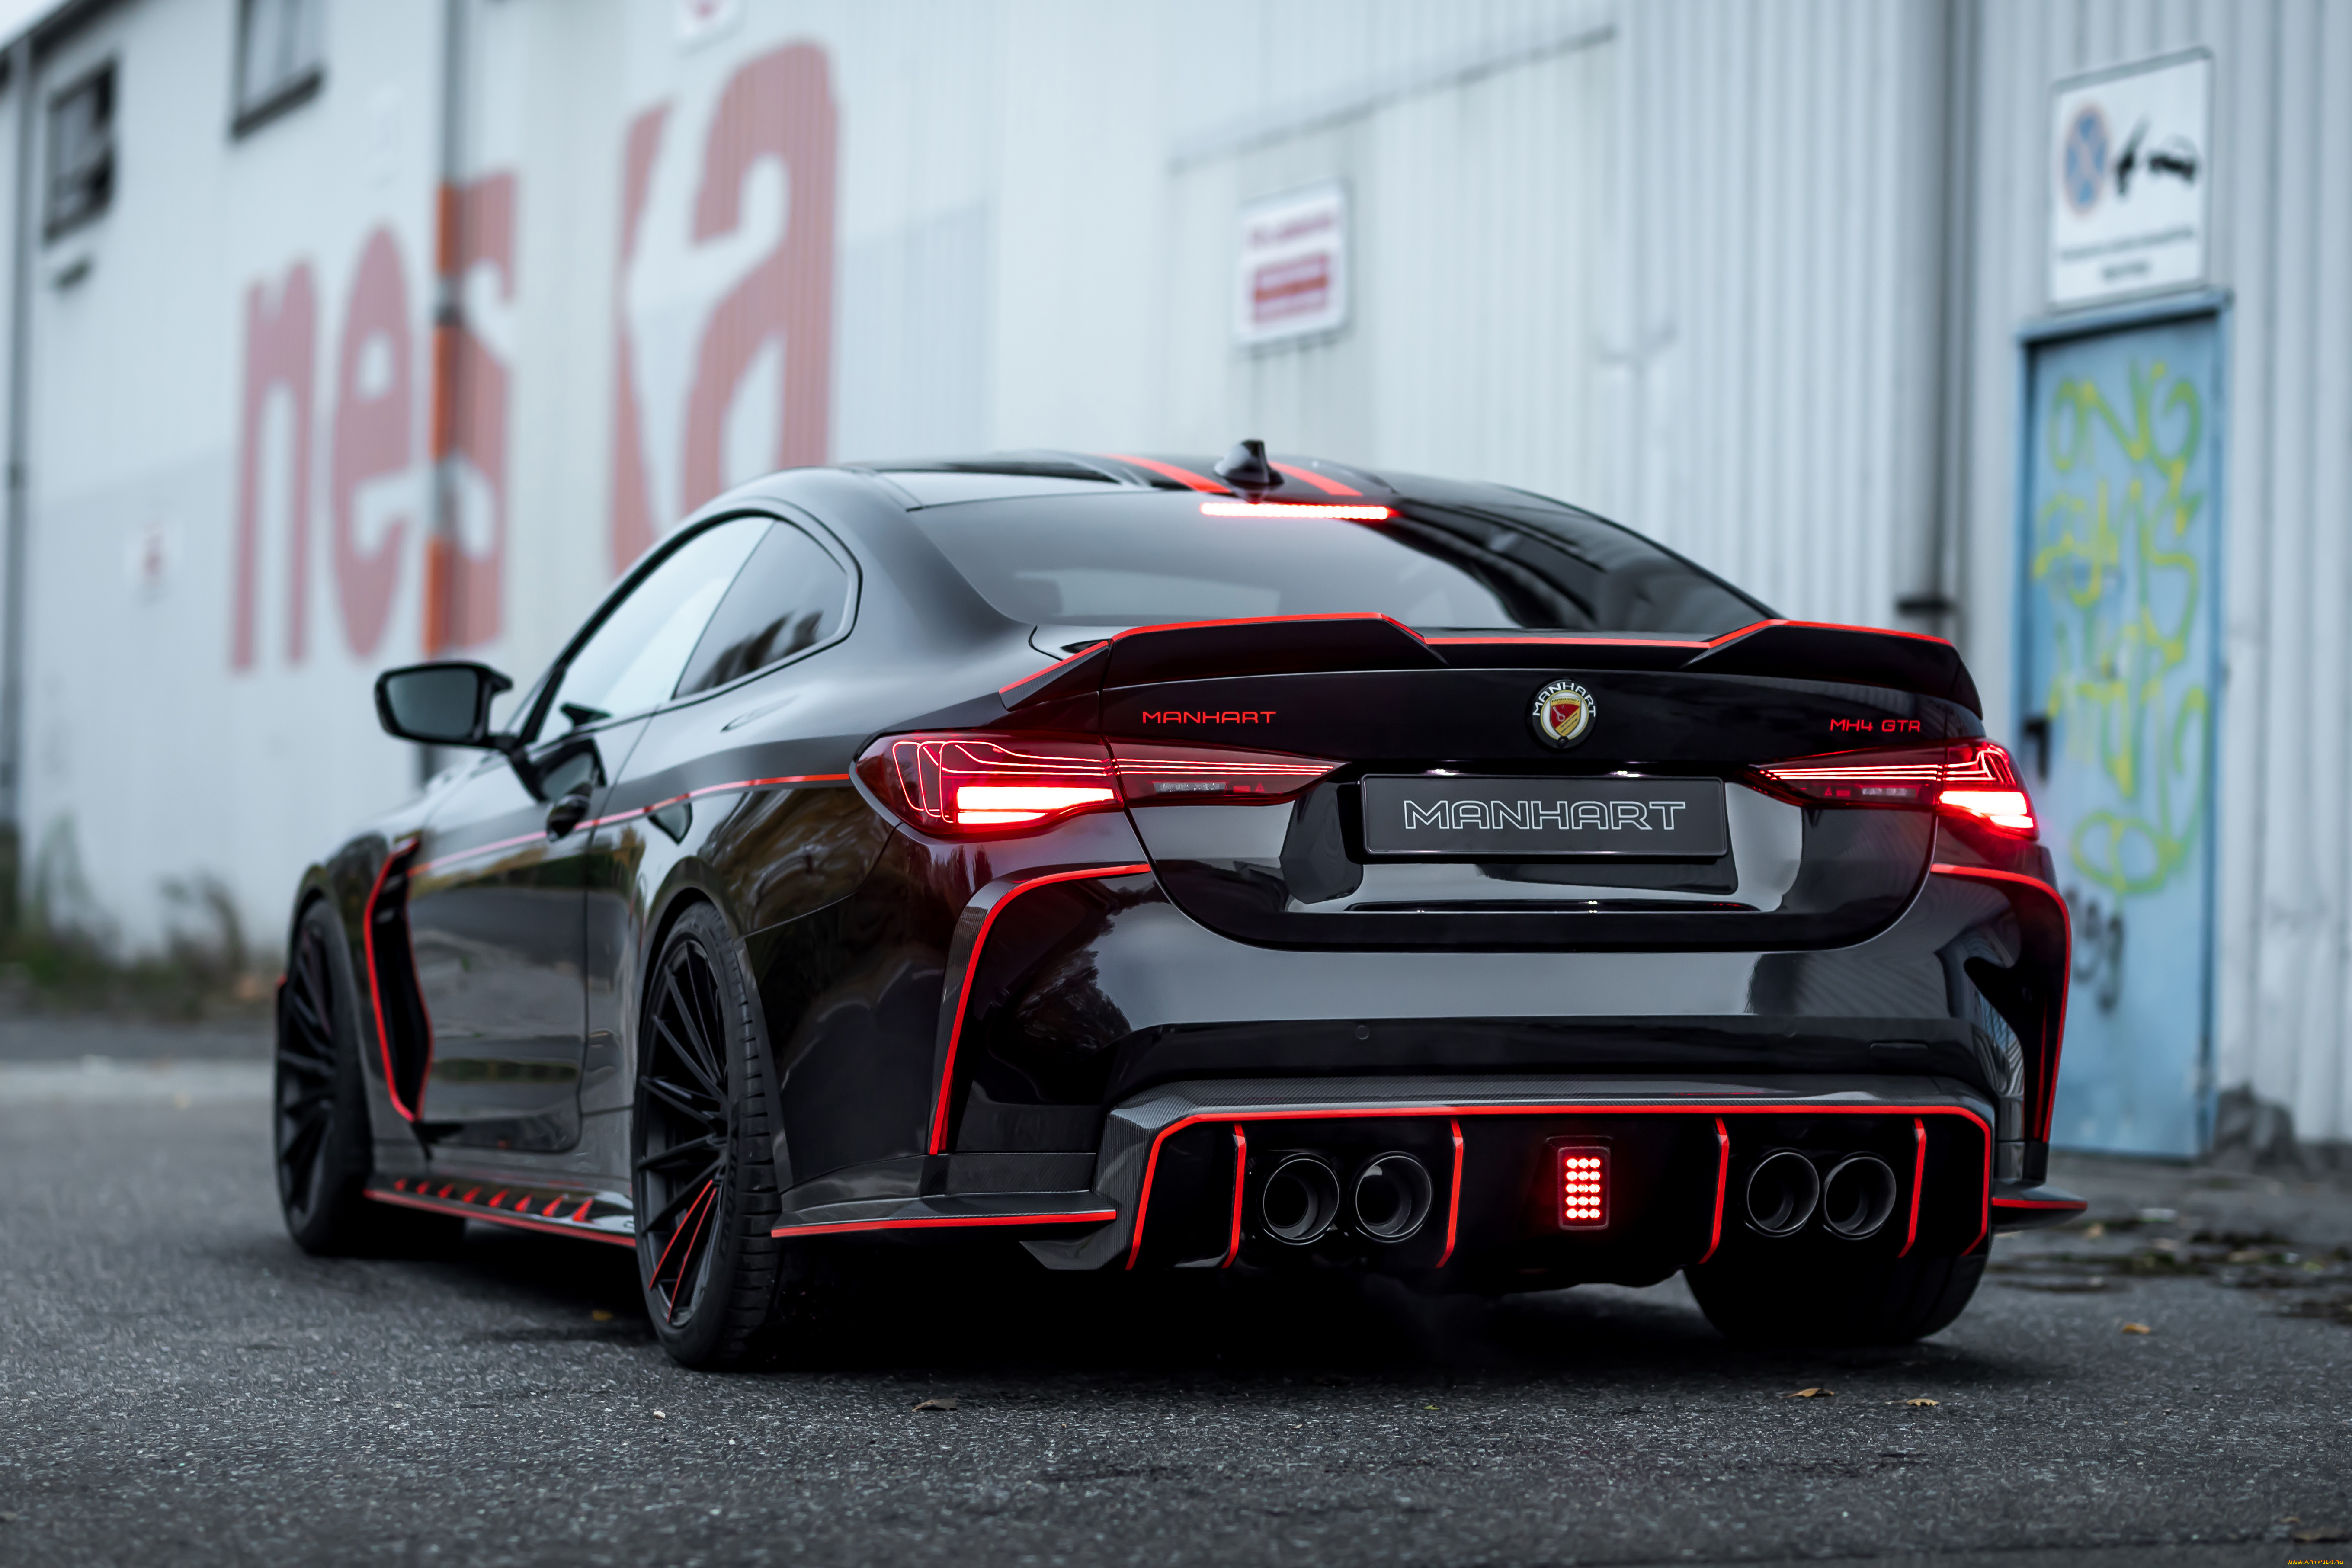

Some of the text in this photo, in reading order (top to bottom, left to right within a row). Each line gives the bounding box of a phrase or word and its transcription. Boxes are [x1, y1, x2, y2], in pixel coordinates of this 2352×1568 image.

[1533, 682, 1596, 717] MANHART
[1143, 712, 1276, 723] MANHART
[1830, 719, 1920, 732] MH4 GTR
[1404, 800, 1686, 830] MANHART
